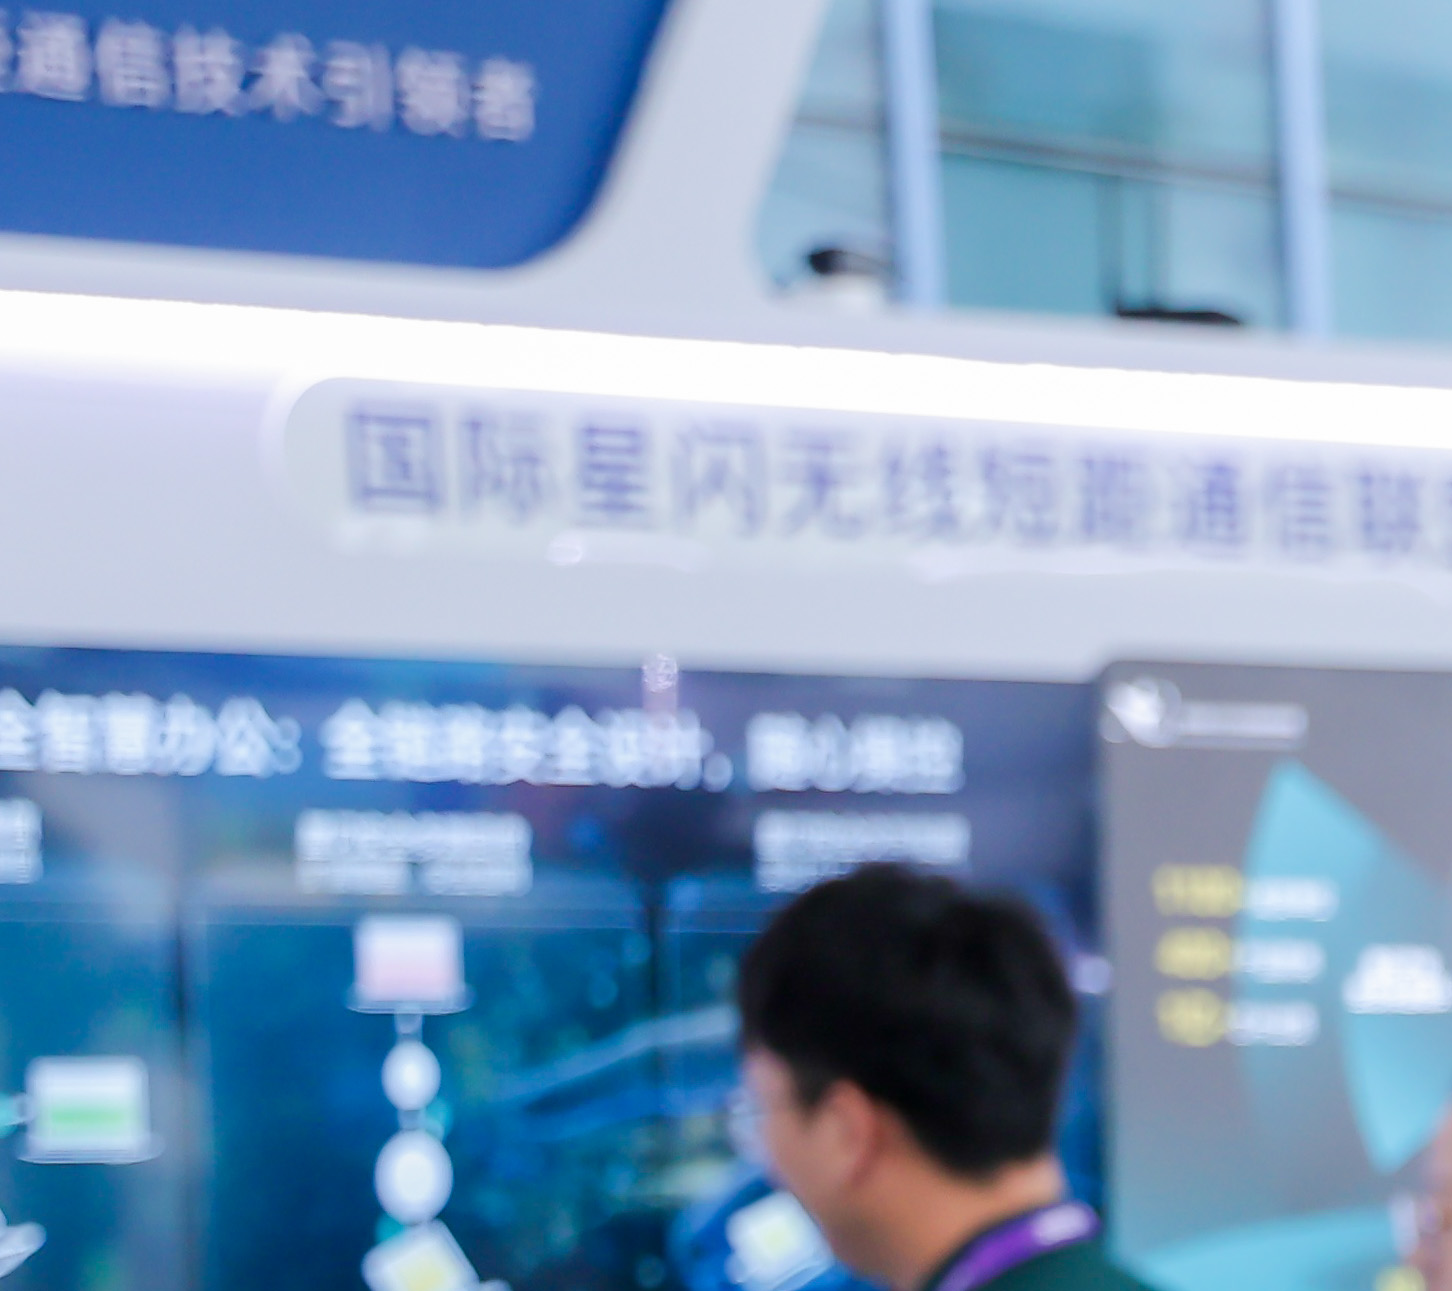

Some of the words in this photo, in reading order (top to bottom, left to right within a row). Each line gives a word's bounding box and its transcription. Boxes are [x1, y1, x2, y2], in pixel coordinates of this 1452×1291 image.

[0, 12, 535, 141] 通信技术引领者
